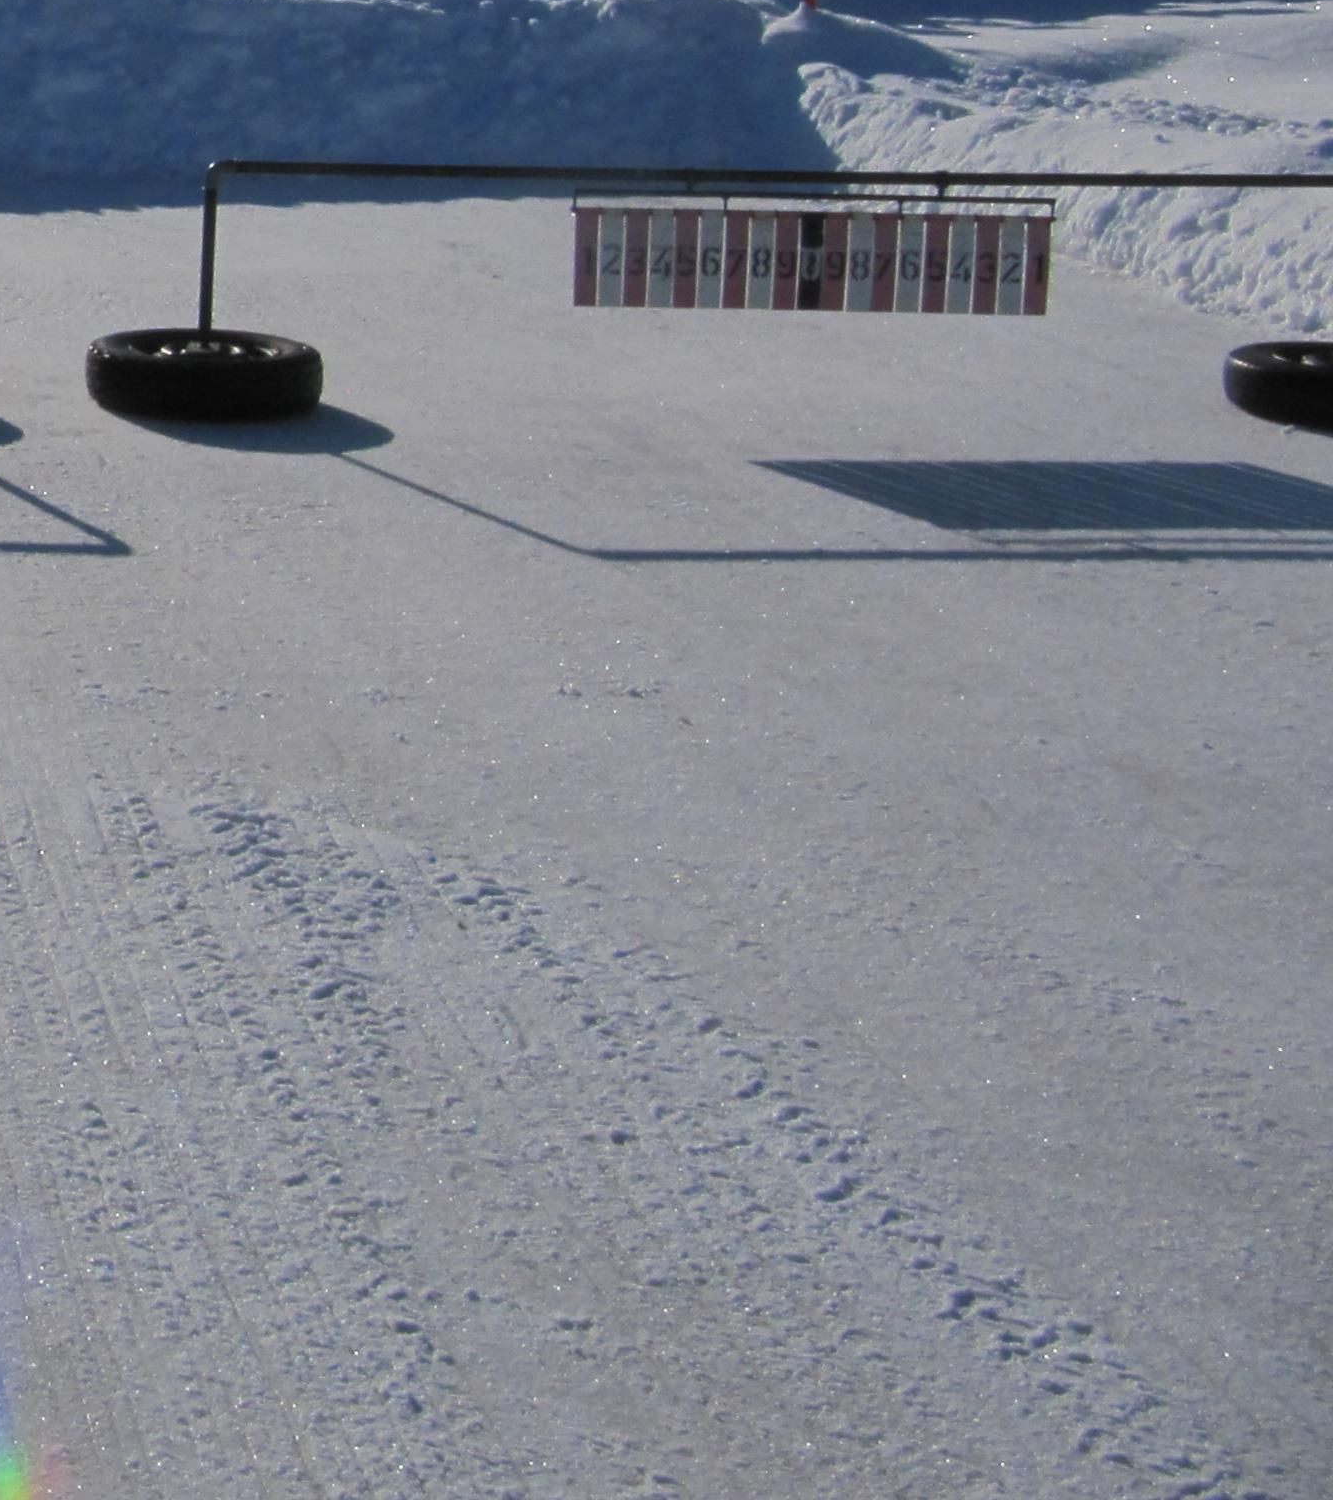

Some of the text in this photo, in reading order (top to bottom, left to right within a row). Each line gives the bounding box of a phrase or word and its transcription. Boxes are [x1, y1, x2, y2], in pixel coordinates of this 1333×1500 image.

[602, 245, 622, 275] 2
[651, 246, 671, 276] 4
[702, 247, 720, 276] 6
[752, 248, 770, 277] 8
[801, 248, 820, 280] 0
[851, 251, 868, 280] 8
[901, 251, 919, 281] 6
[950, 253, 970, 282] 4
[1001, 252, 1020, 283] 2
